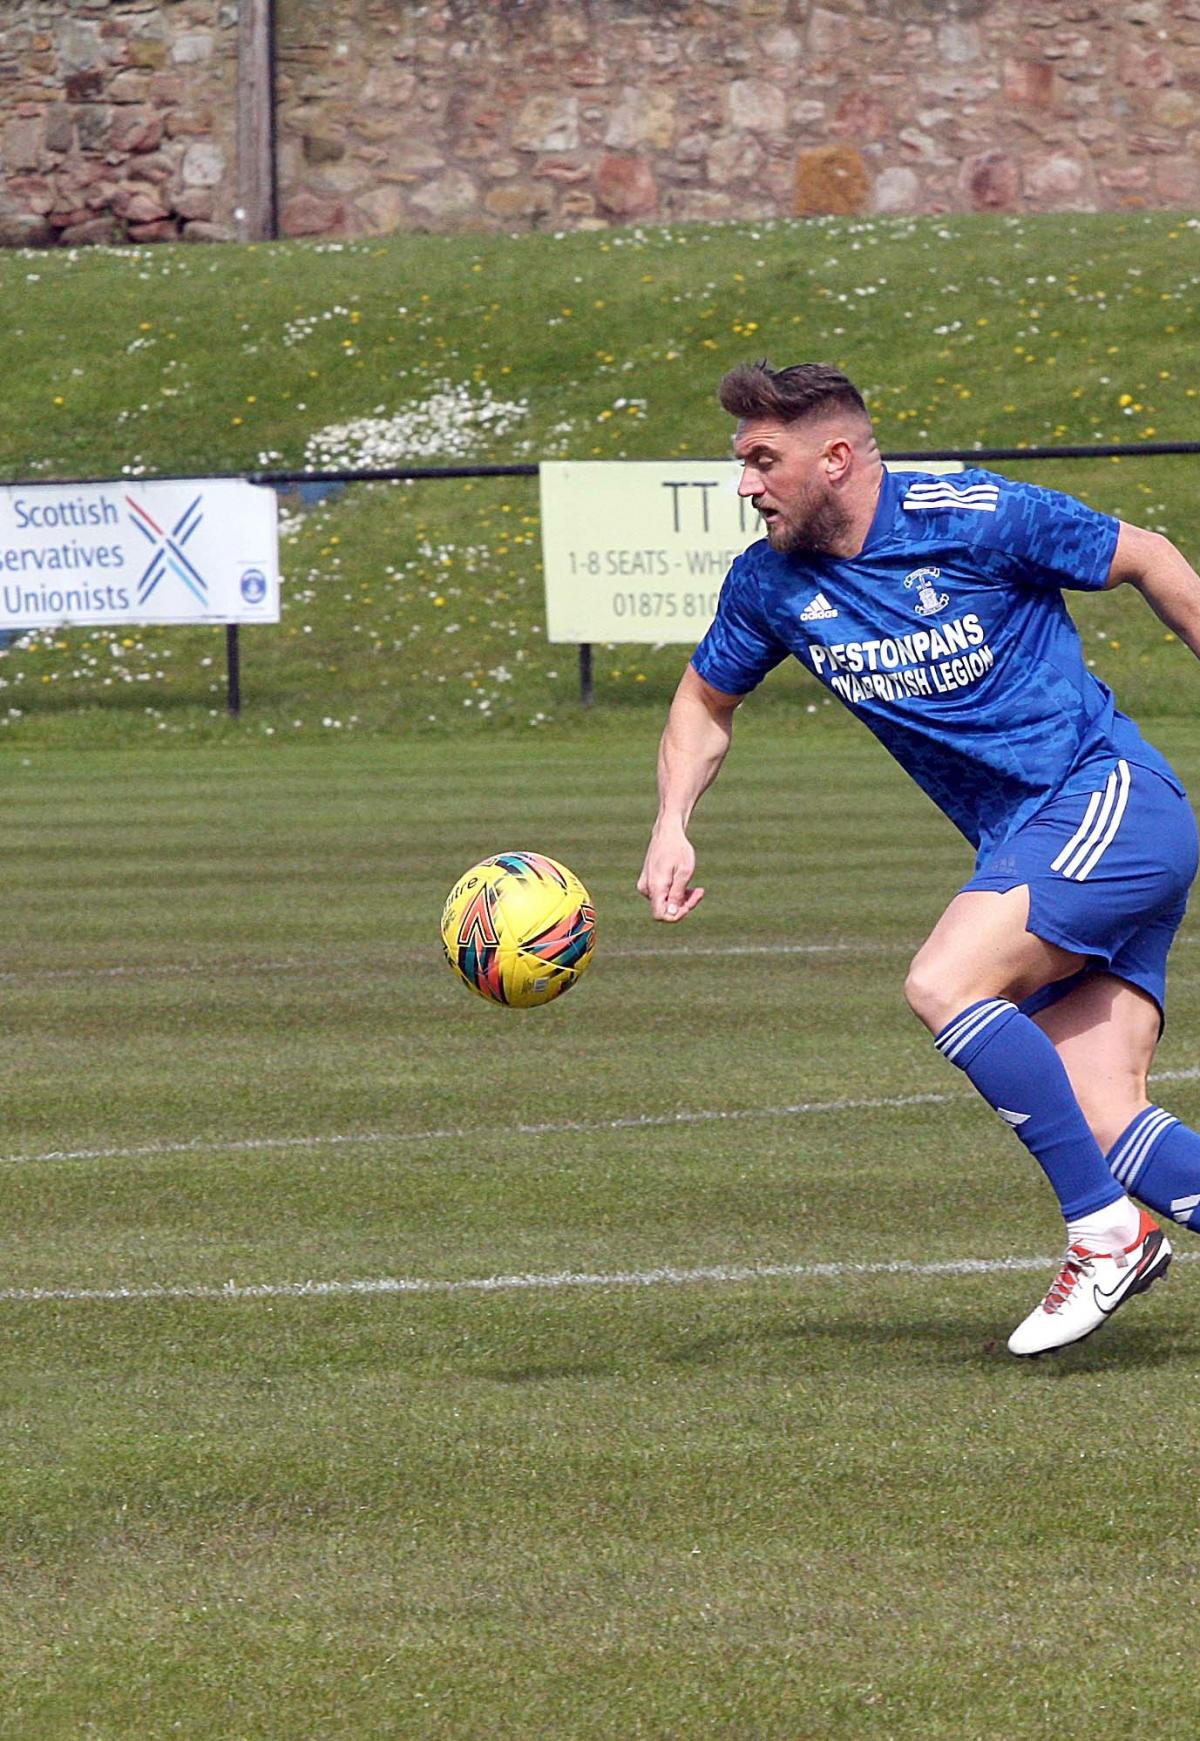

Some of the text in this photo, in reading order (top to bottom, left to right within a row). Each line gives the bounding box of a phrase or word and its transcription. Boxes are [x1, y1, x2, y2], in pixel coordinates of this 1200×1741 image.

[14, 495, 119, 528] Scottish
[662, 481, 719, 533] TT
[568, 551, 601, 576] 1-8
[606, 550, 669, 576] SEATS
[4, 585, 130, 614] Unionists
[612, 593, 677, 618] 01875
[800, 608, 838, 622] adidas
[930, 645, 995, 694] LEGION
